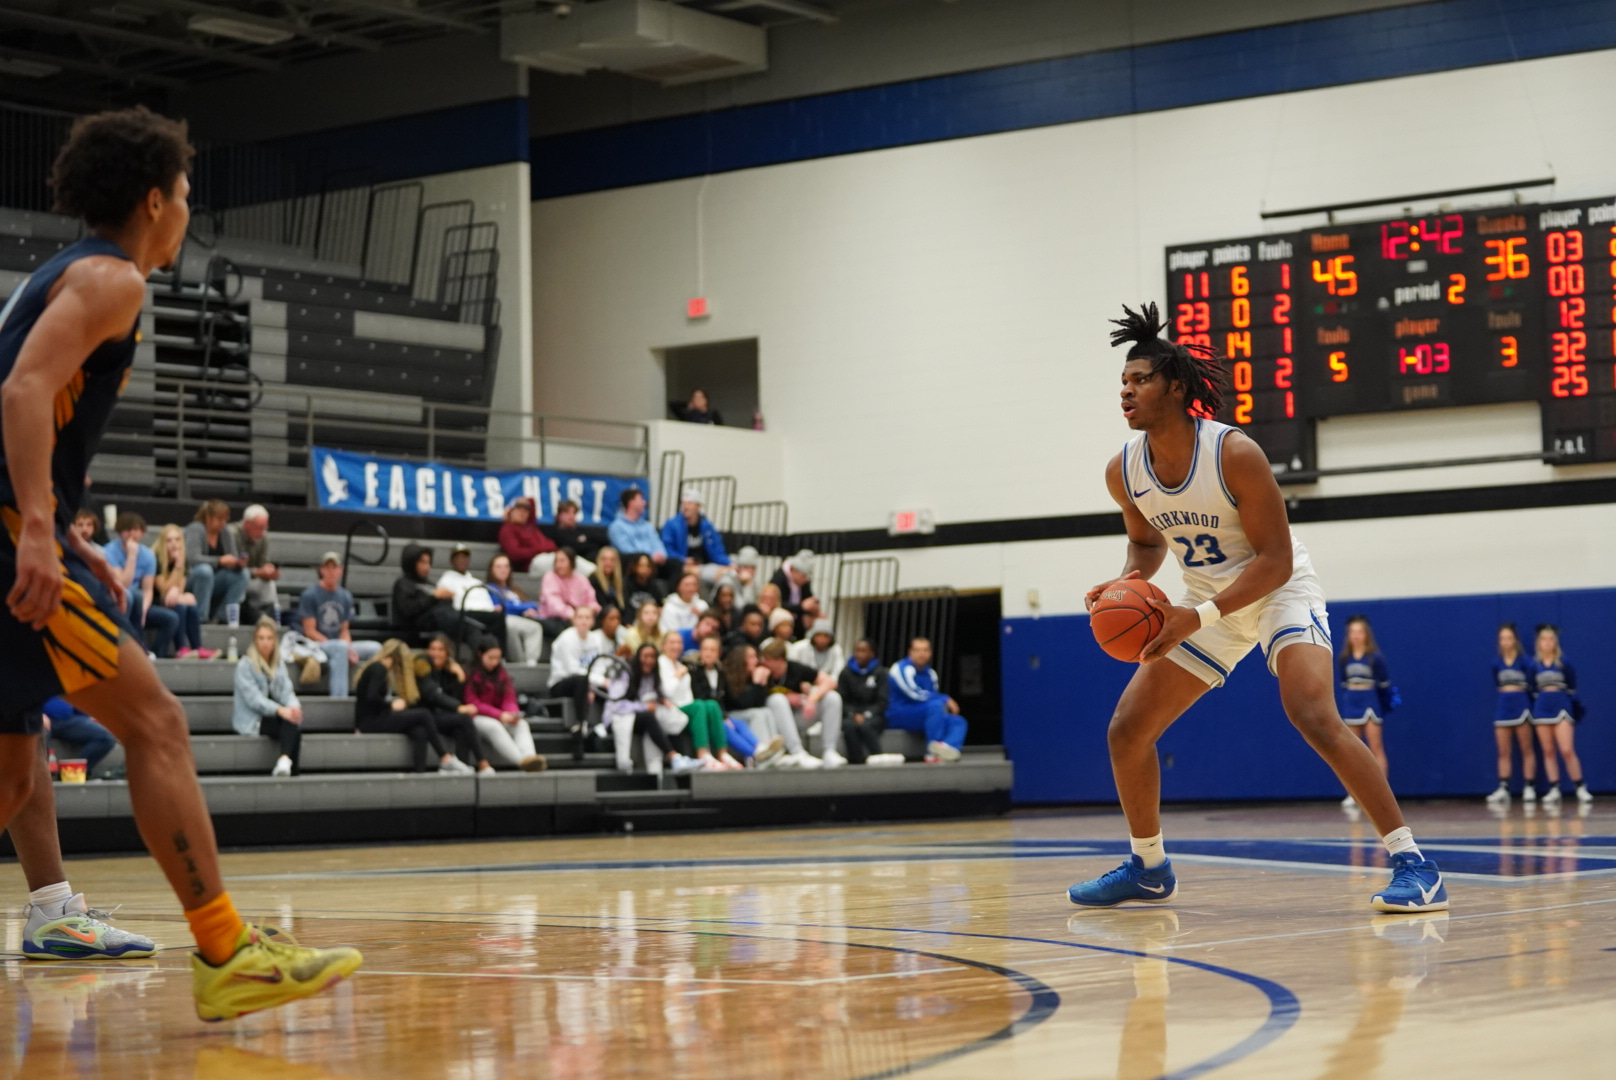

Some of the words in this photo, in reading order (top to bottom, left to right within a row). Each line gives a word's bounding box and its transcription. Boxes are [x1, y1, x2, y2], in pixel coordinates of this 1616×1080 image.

[1539, 207, 1582, 231] player
[1380, 214, 1464, 260] 12:42
[1546, 230, 1583, 263] 03
[1169, 249, 1209, 272] player
[1212, 243, 1251, 266] points
[1484, 236, 1530, 281] 36
[1184, 271, 1210, 300] 11
[1230, 265, 1250, 297] 6
[1280, 263, 1291, 290] 1
[1312, 254, 1358, 296] 45
[1394, 280, 1440, 306] period
[1447, 273, 1467, 305] 2
[1548, 264, 1585, 297] 00
[1176, 301, 1211, 334] 23
[1231, 297, 1251, 329] 0
[1273, 293, 1292, 325] 2
[1559, 297, 1586, 329] 12
[1226, 330, 1252, 360] 14
[1283, 326, 1293, 354] 1
[1500, 335, 1519, 368] 3
[1551, 330, 1587, 364] 32
[1233, 361, 1253, 392] 0
[1275, 357, 1293, 389] 2
[1328, 350, 1349, 383] 5
[1551, 364, 1589, 398] 25
[1235, 392, 1254, 425] 2
[1285, 391, 1295, 419] 1
[363, 461, 505, 519] EAGLES
[521, 474, 607, 524] NEST
[1150, 510, 1219, 532] KIRKWOOD
[1172, 533, 1228, 567] 23
